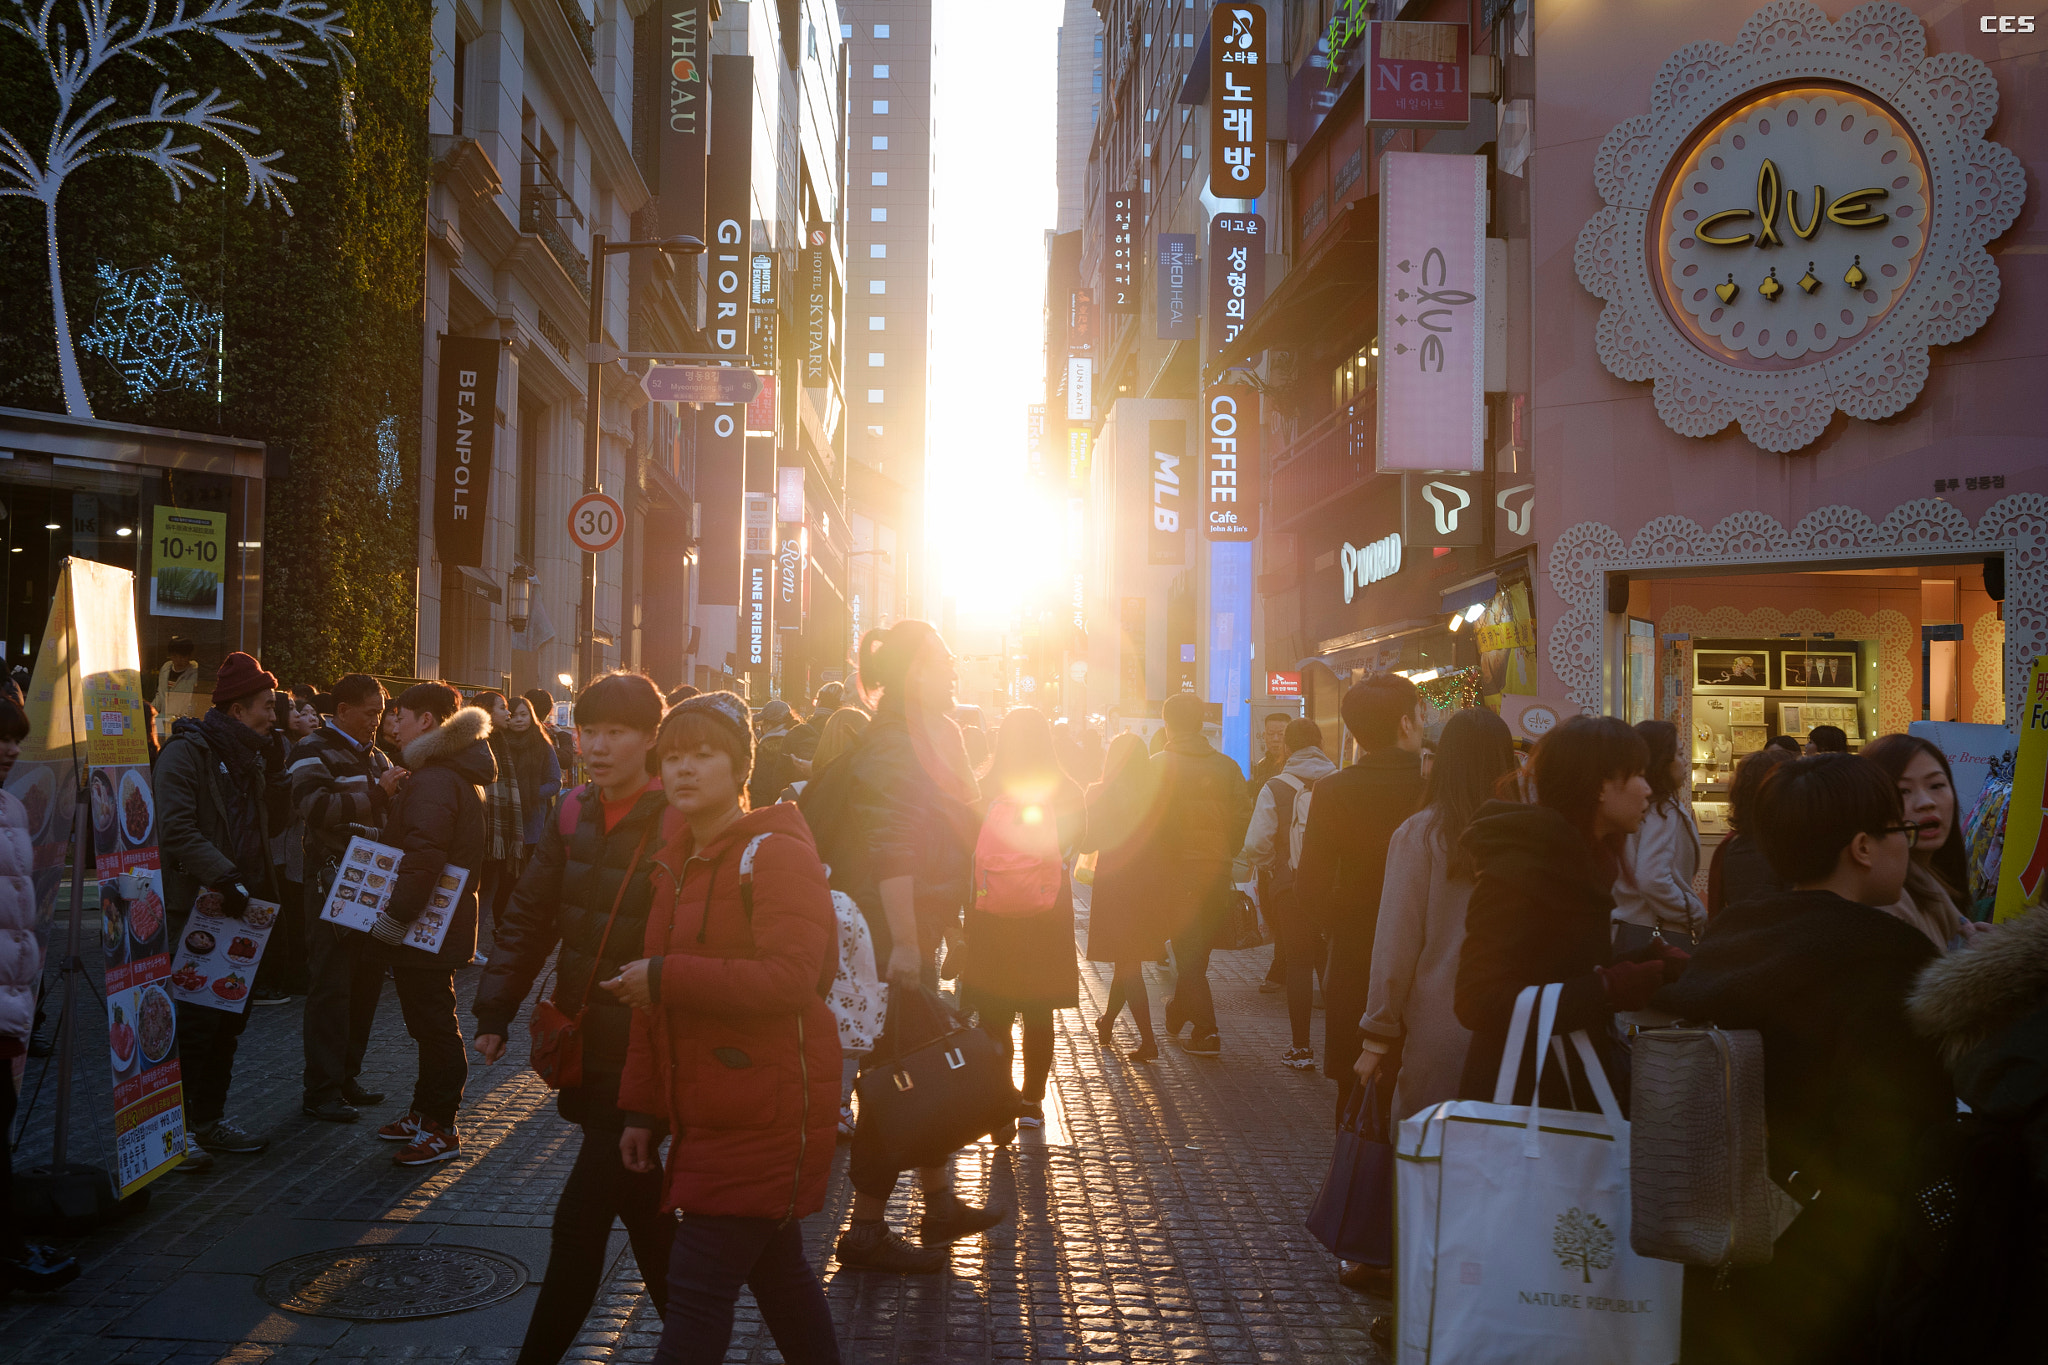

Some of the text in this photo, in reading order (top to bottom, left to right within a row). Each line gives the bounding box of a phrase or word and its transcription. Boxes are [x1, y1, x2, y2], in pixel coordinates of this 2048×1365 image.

[1222, 51, 1258, 65] 스타몰
[1376, 64, 1463, 93] Nail
[1396, 98, 1445, 111] 네일아트
[1222, 72, 1256, 181] 노래방
[1220, 219, 1258, 235] 미고운
[752, 269, 761, 304] EKONOMY
[762, 269, 771, 294] HOTEL
[1171, 252, 1184, 328] MEDIHEAL
[809, 251, 823, 379] HOTEL SKYPARK
[652, 380, 662, 388] 52
[453, 370, 477, 520] BEANPOLE
[1210, 395, 1238, 503] COFFEE
[1154, 451, 1180, 533] MLB
[1965, 475, 2004, 490] 명동점
[579, 510, 613, 535] 30
[1210, 511, 1238, 523] Cafe
[160, 537, 217, 562] 10+10
[779, 539, 801, 603] Roem
[750, 568, 763, 664] LINE FRIENDS
[1518, 1291, 1654, 1313] NATURE REPUBLIC
